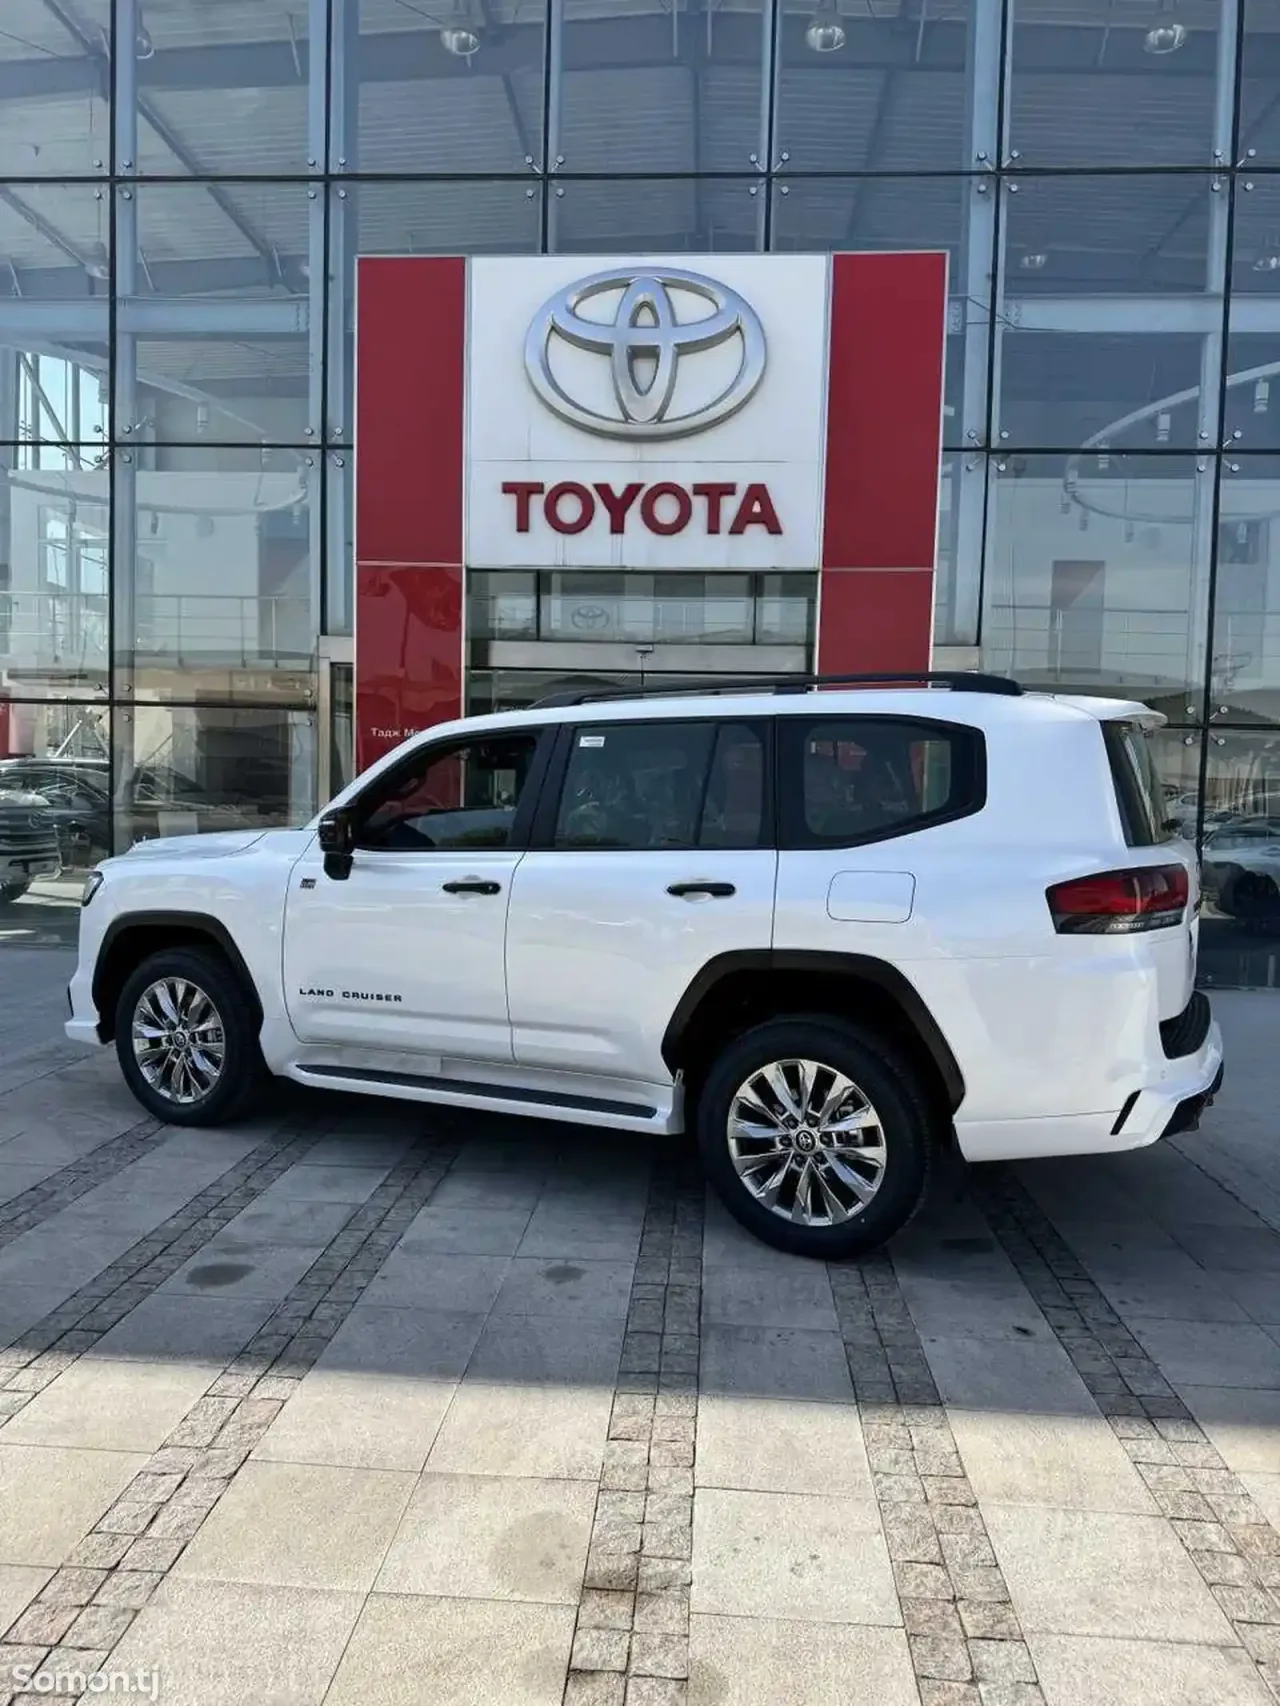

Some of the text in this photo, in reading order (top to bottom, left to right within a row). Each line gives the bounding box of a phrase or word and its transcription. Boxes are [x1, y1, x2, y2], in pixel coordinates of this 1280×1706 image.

[501, 481, 784, 536] TOYOTA
[299, 988, 402, 1002] LAND CRUISER
